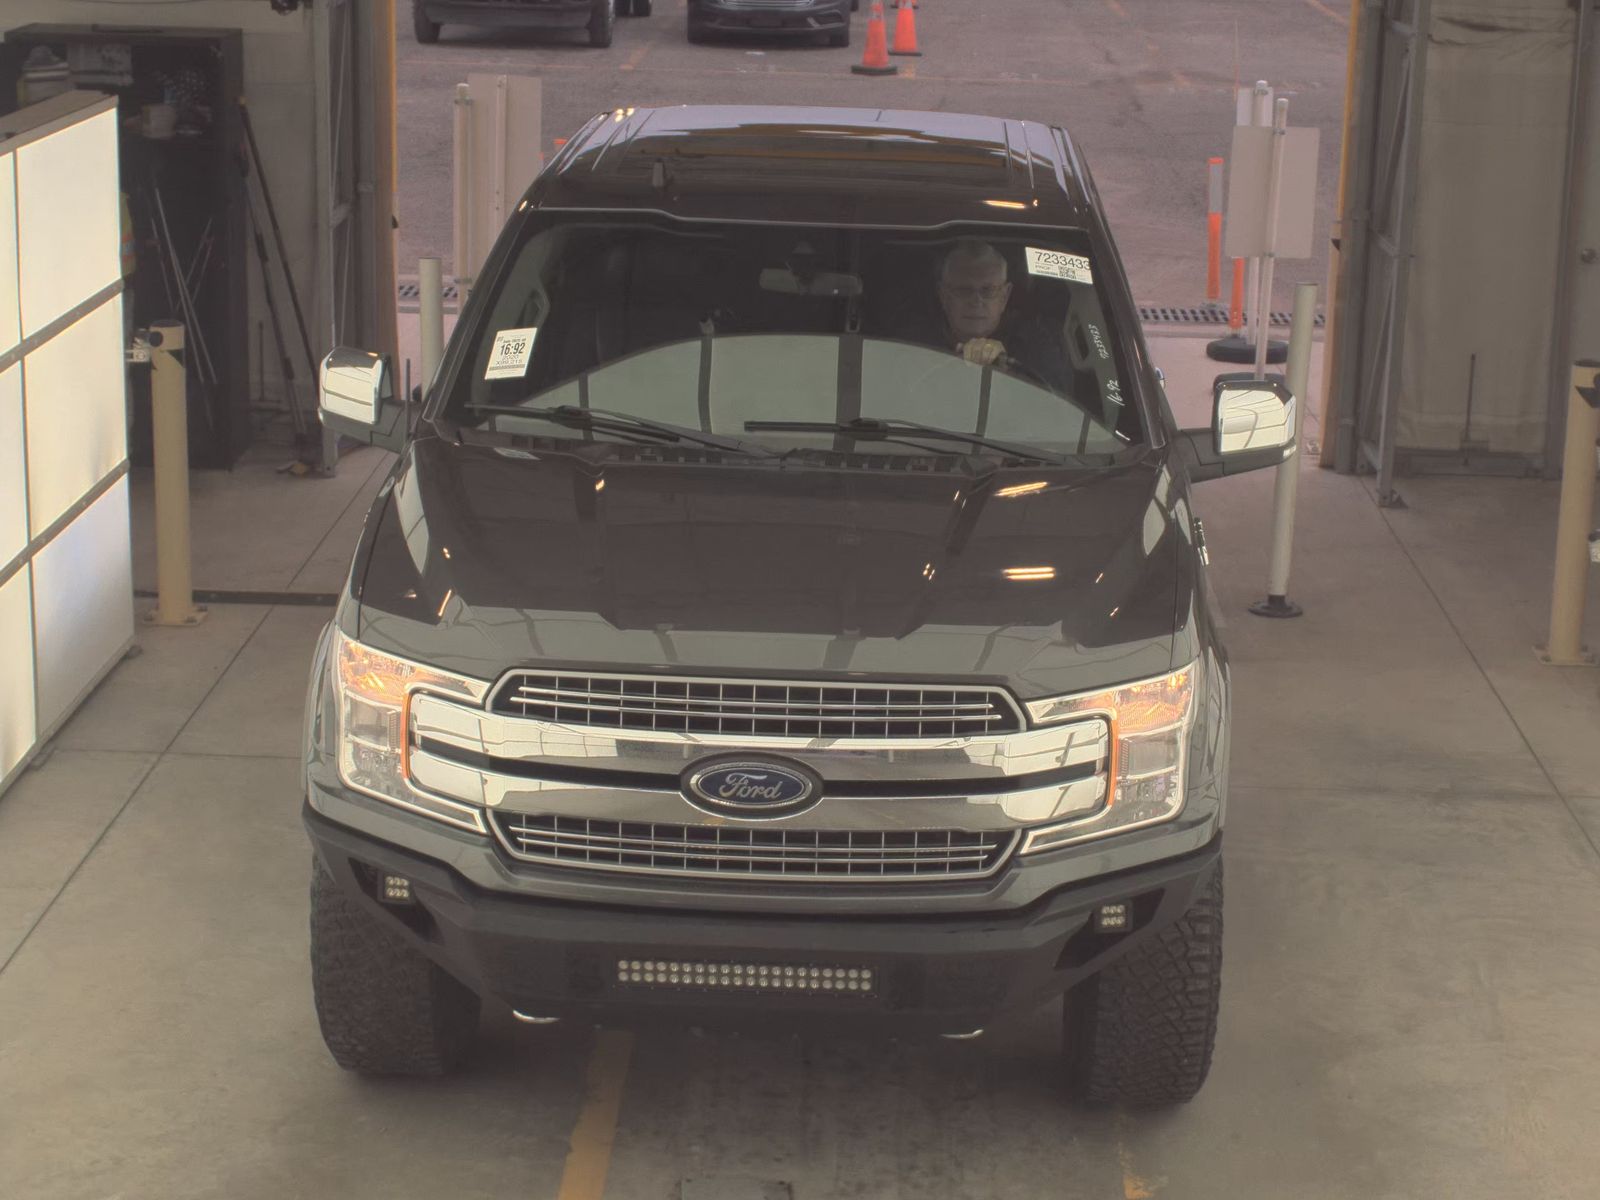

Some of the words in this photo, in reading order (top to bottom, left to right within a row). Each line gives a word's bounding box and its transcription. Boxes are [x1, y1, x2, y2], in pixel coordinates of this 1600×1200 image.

[1035, 251, 1090, 270] 7233433
[500, 342, 526, 356] 16:92
[719, 772, 783, 799] Ford
